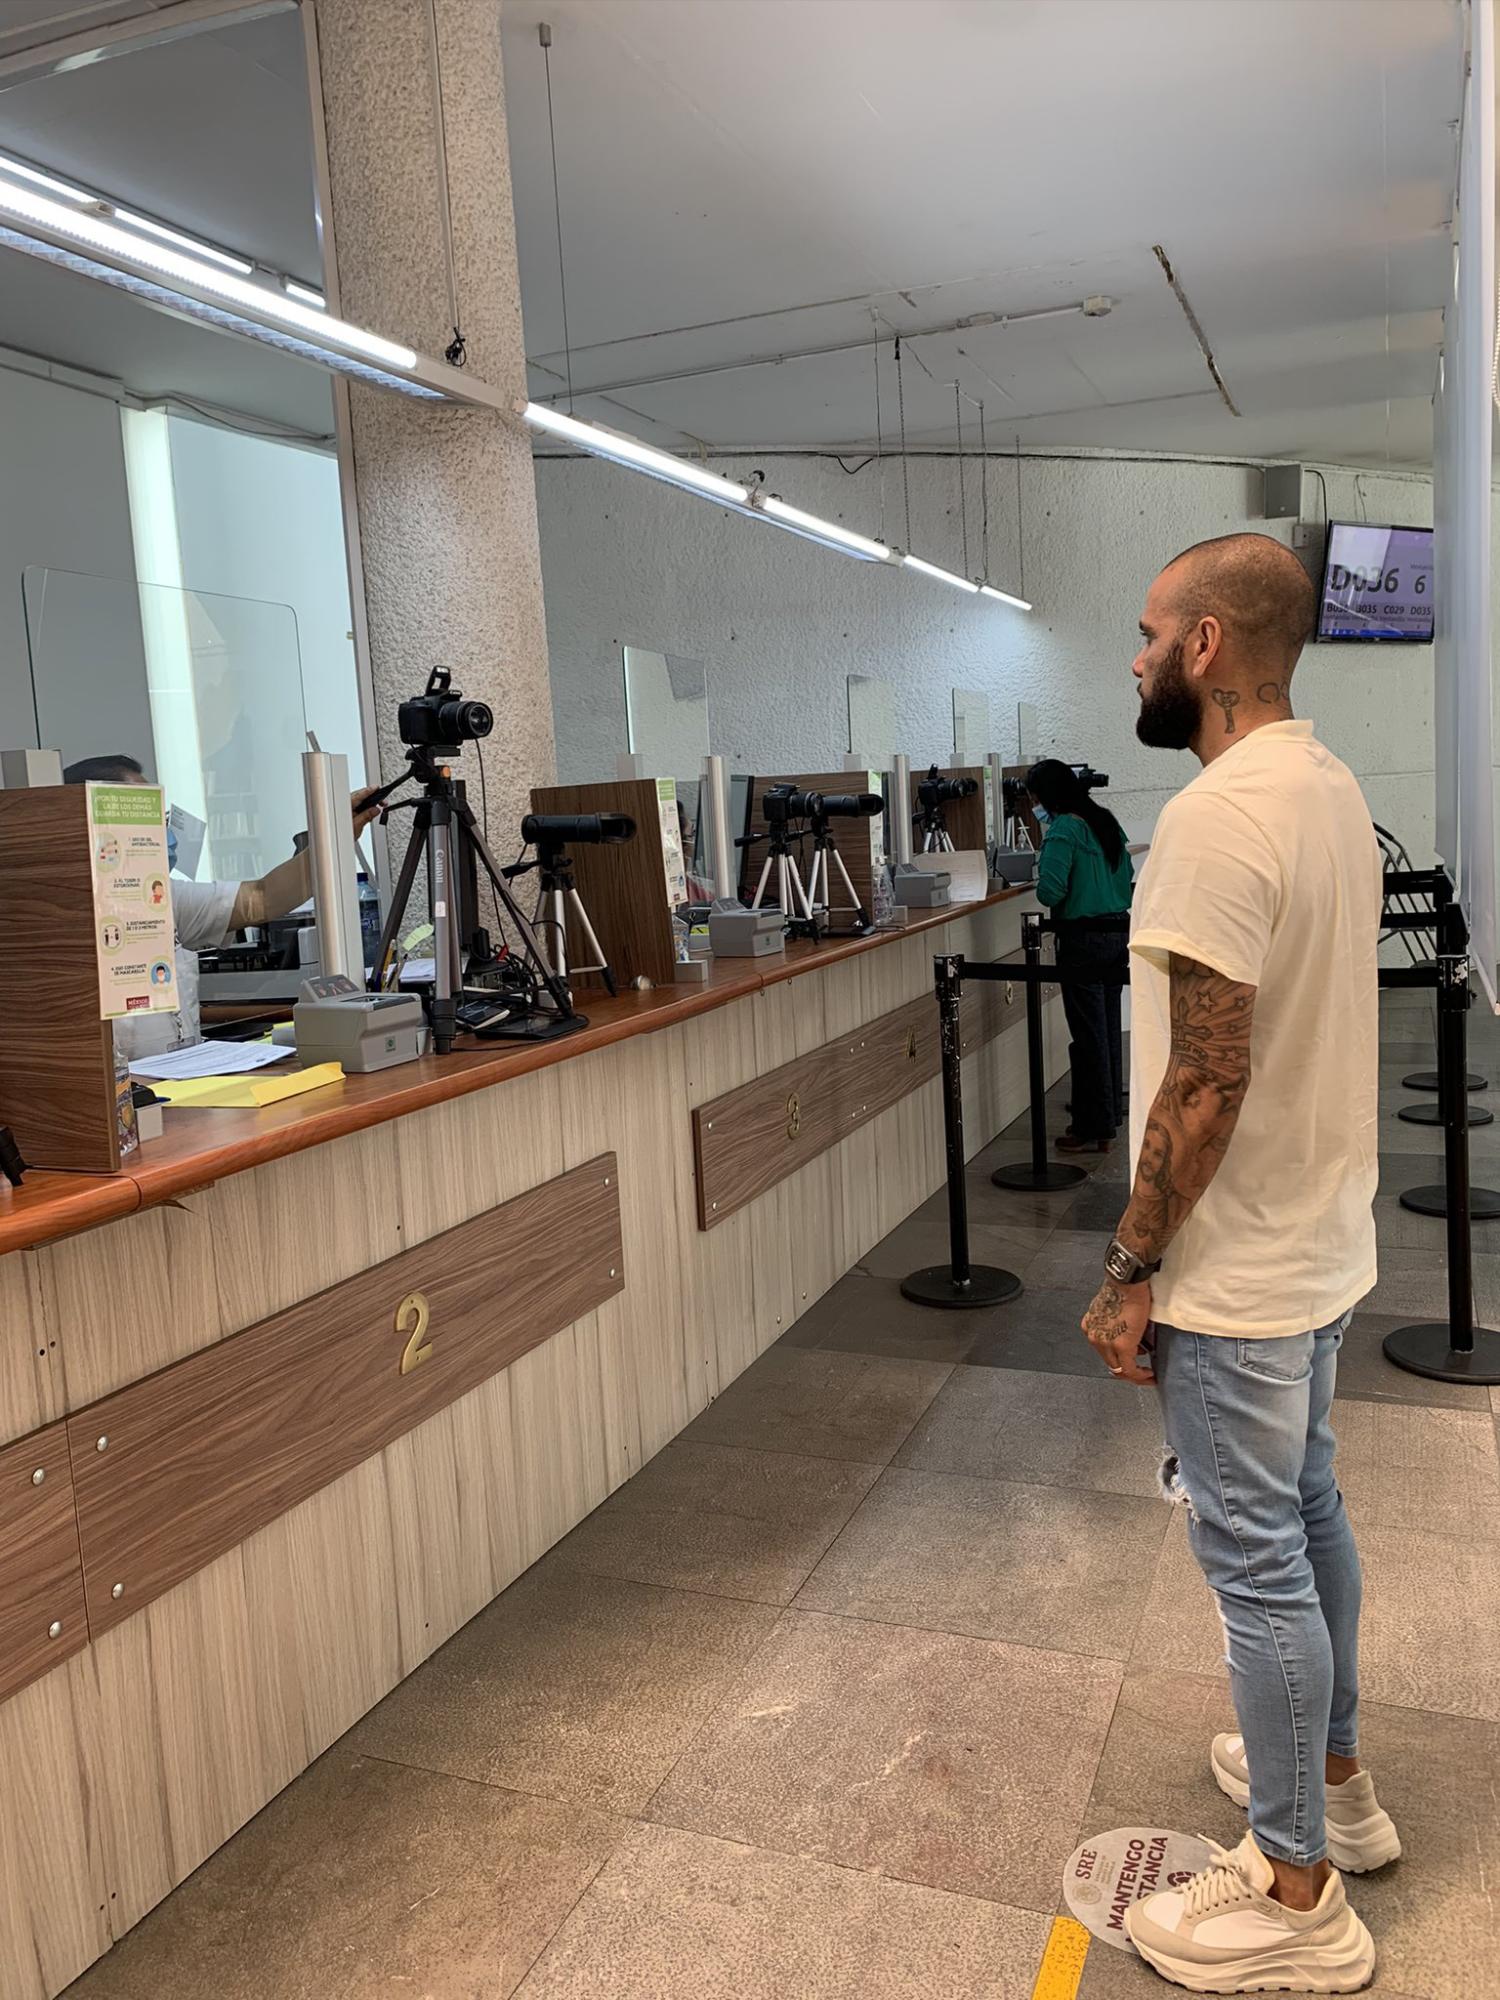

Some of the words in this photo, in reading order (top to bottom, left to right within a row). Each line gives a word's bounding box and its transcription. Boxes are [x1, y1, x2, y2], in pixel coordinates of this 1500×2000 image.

[1330, 564, 1399, 593] D036
[1415, 575, 1427, 594] 6
[1383, 604, 1405, 615] C029
[1410, 606, 1432, 616] D035
[435, 848, 445, 884] Canon
[786, 1091, 800, 1140] 3
[395, 1291, 434, 1375] 2
[1075, 1848, 1098, 1880] SRE
[1106, 1838, 1146, 1931] MANTENGO
[1136, 1836, 1169, 1901] STANCIA
